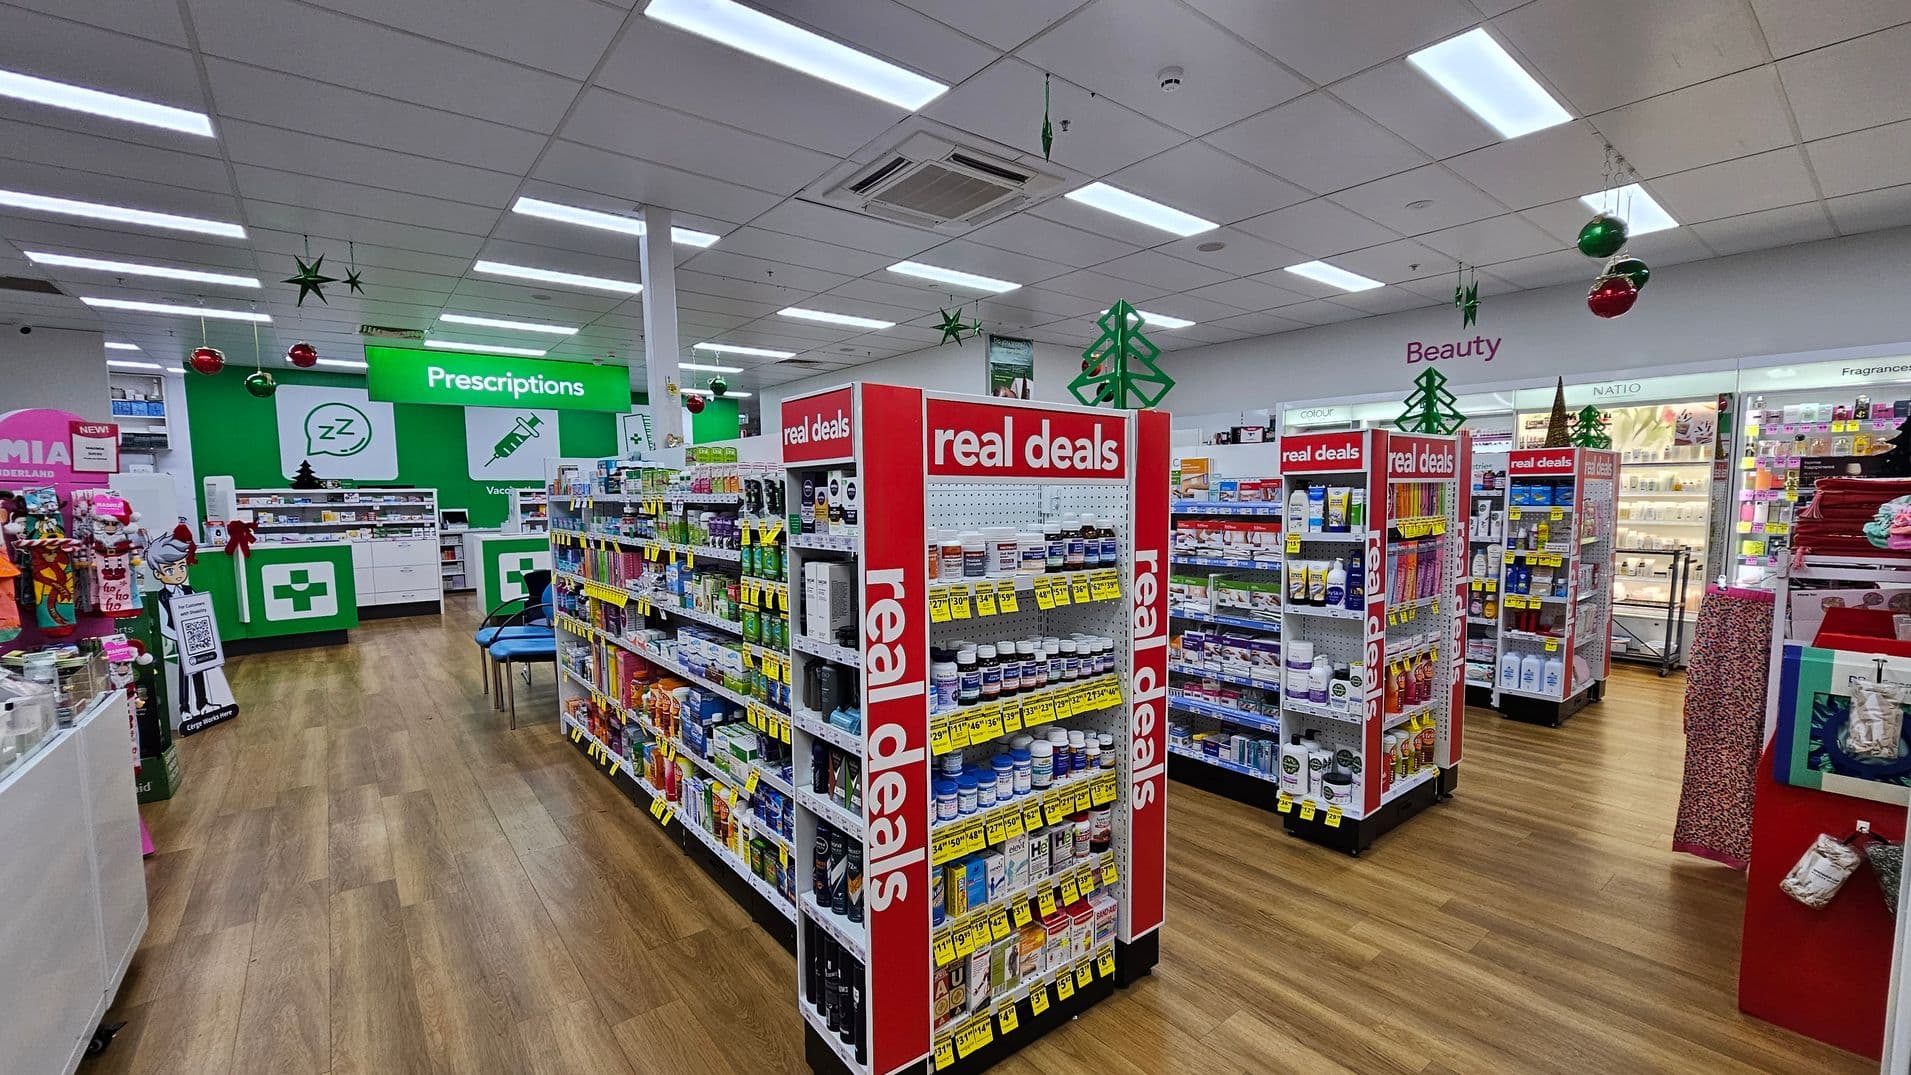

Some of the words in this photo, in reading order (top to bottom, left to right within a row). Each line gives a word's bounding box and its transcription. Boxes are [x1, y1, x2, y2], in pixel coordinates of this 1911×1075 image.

[1407, 336, 1501, 364] Beauty
[427, 366, 585, 399] Prescriptions
[1593, 383, 1641, 396] NATIO
[79, 425, 110, 434] NEW!
[784, 416, 809, 446] real
[812, 409, 849, 442] deals
[1300, 407, 1335, 420] colour
[934, 416, 1013, 468] real
[1025, 419, 1118, 471] deals
[1282, 445, 1315, 463] real
[1318, 442, 1360, 461] deals
[1389, 443, 1416, 474] real
[1419, 444, 1454, 474] deals
[1511, 457, 1534, 469] real
[1537, 456, 1573, 468] deals
[1367, 529, 1385, 605] real
[1454, 521, 1467, 584] real
[1134, 549, 1167, 651] real
[866, 568, 925, 703] real
[1451, 595, 1465, 686] deals
[1365, 615, 1384, 722] deals
[1133, 667, 1165, 810] deals
[867, 723, 926, 912] deals
